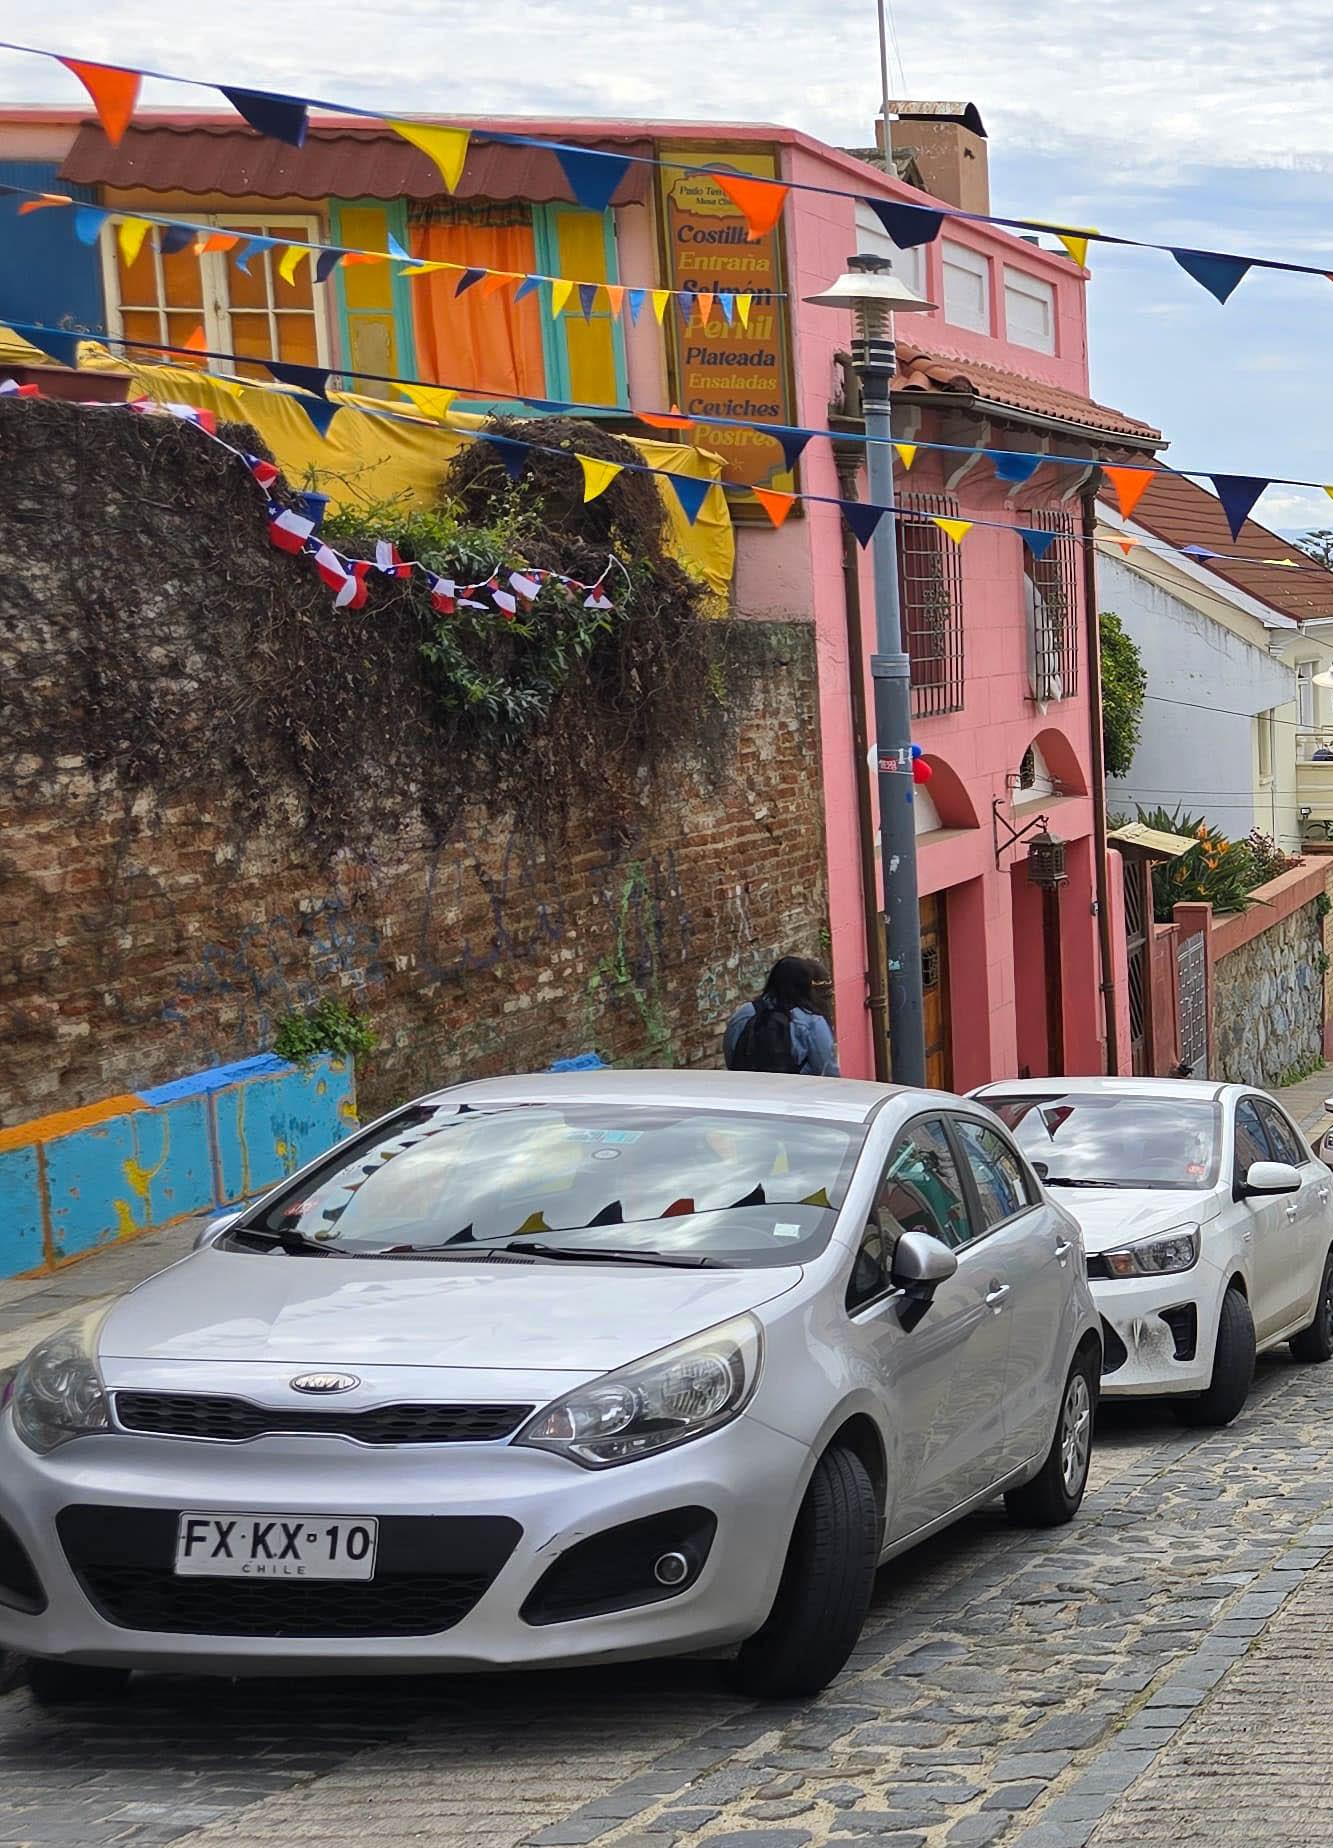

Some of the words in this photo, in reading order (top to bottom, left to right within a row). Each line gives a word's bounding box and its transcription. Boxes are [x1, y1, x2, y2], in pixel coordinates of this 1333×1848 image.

[678, 250, 770, 272] Entraña
[683, 314, 774, 340] Pernil
[685, 346, 776, 367] Plateada
[688, 372, 777, 391] Ensaladas
[688, 398, 780, 418] Ceviches
[693, 424, 777, 448] Postres
[242, 1563, 306, 1575] CHILE
